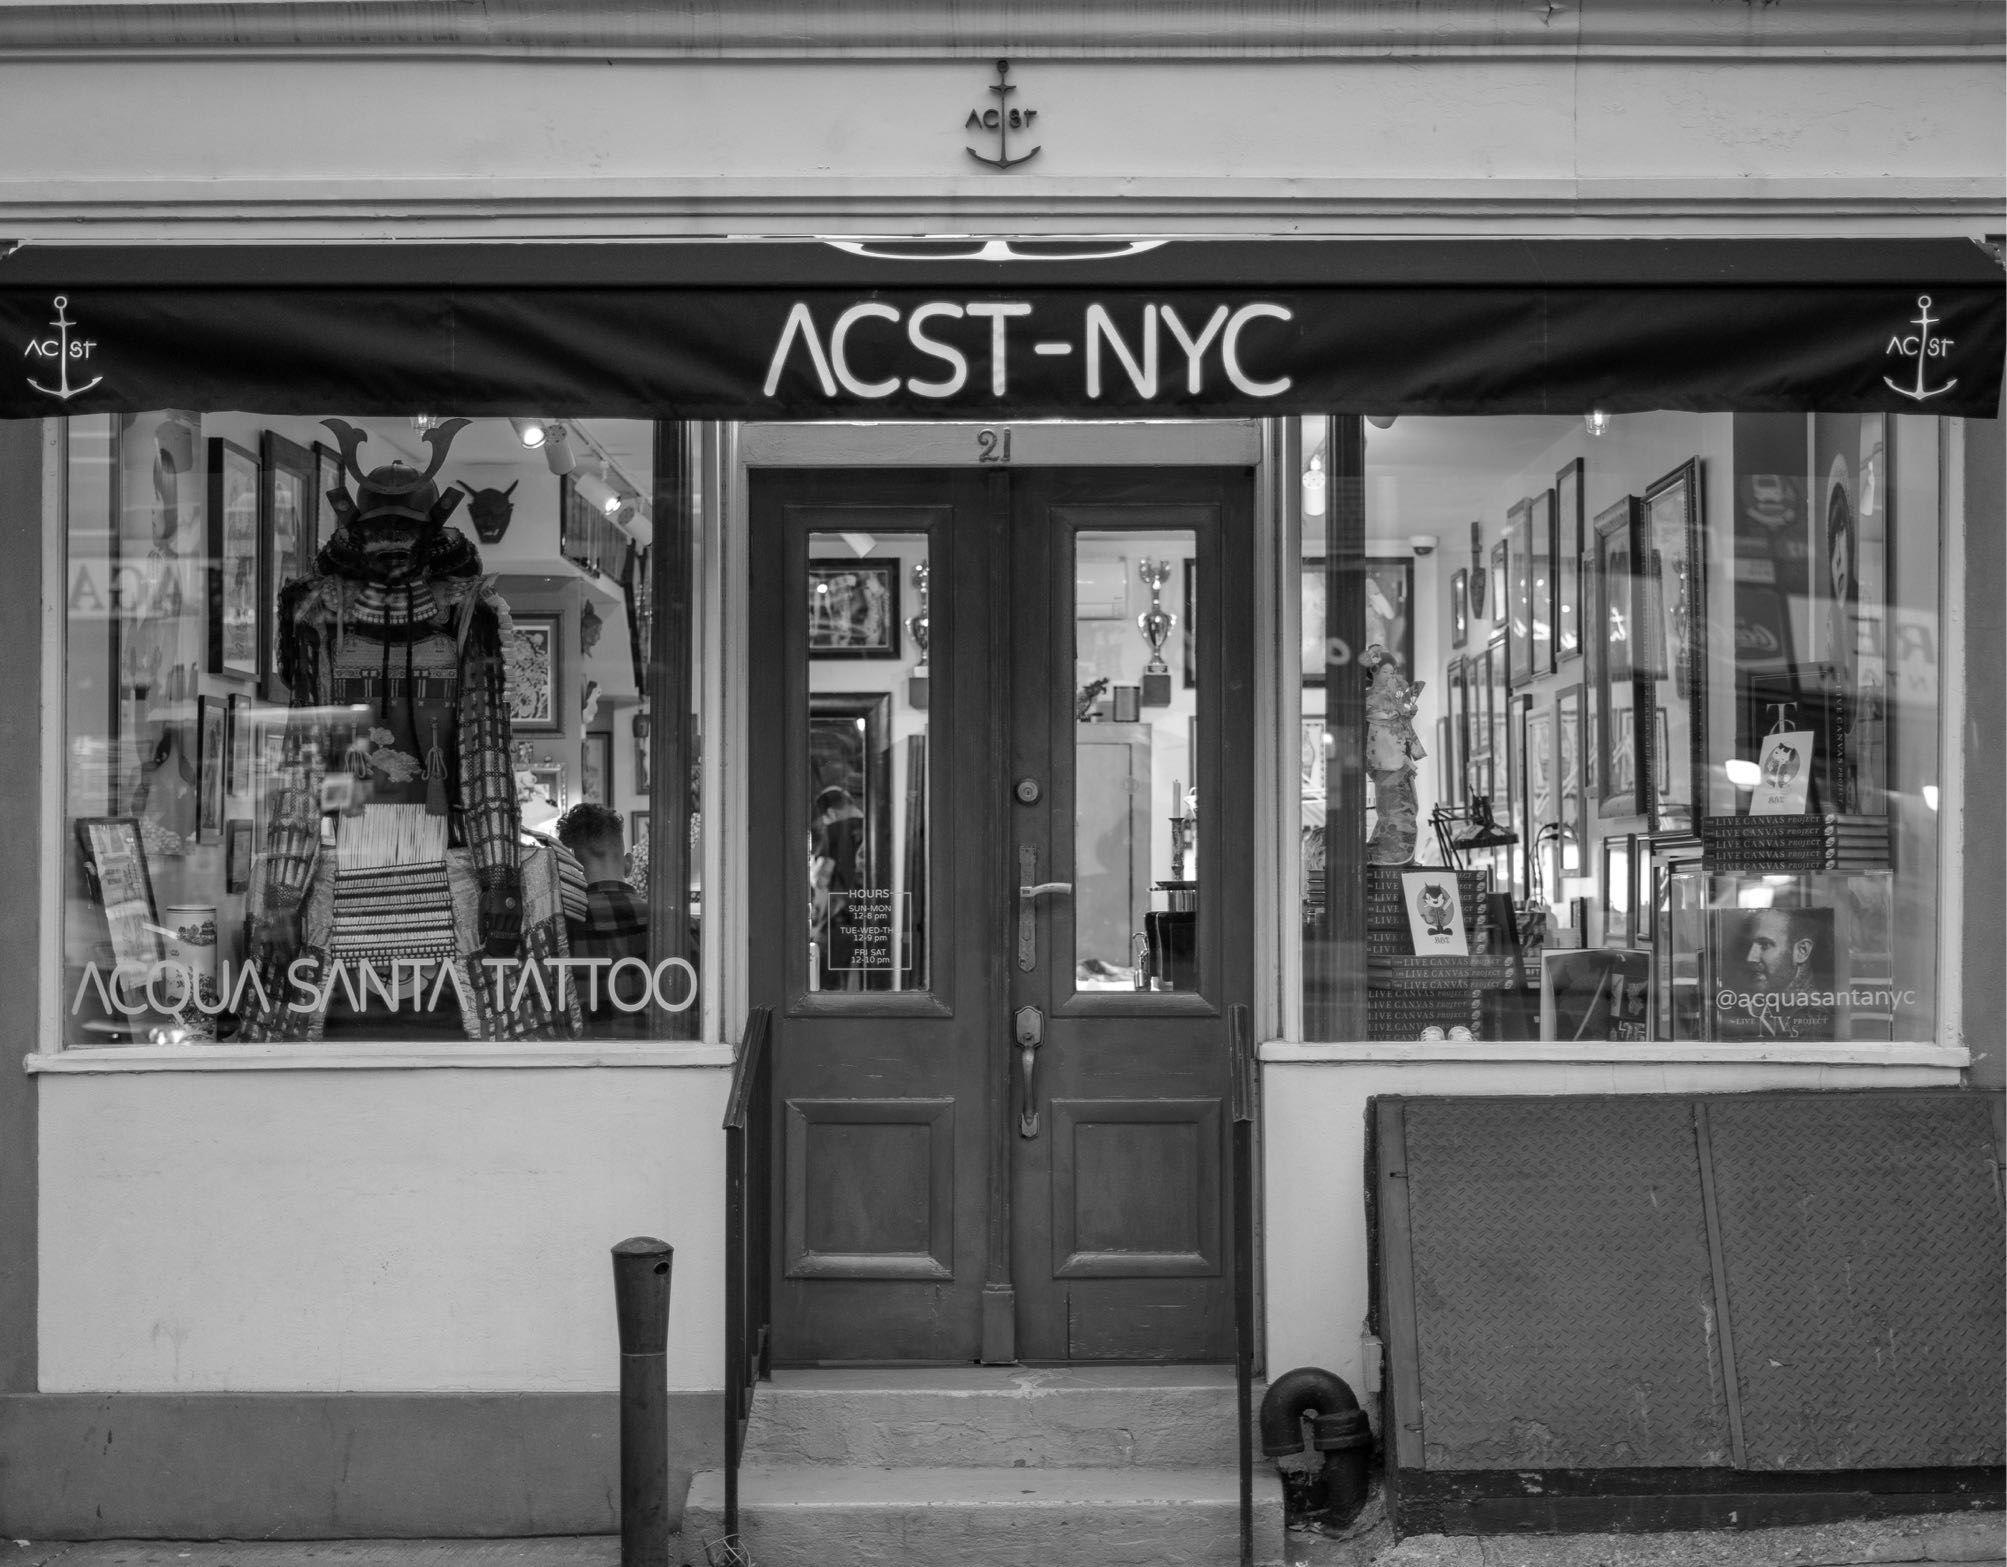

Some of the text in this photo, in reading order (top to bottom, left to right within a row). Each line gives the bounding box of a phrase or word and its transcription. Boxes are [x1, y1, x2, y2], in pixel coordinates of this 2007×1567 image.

[977, 427, 1012, 464] 21
[1836, 716, 1844, 764] CANVAS
[1716, 818, 1741, 826] LIVE
[1743, 816, 1785, 825] CANVAS
[1787, 815, 1820, 825] PROJECT
[1715, 829, 1740, 837] LIVE
[1742, 827, 1784, 836] CANVAS
[1786, 827, 1820, 836] PROJECT
[1716, 840, 1741, 849] LIVE
[1743, 839, 1785, 848] CANVAS
[1787, 839, 1821, 848] PROJECT
[1716, 852, 1741, 860] LIVE
[1743, 850, 1785, 859] CANVAS
[1787, 850, 1821, 860] PROJECT
[1716, 863, 1741, 872] LIVE
[1743, 862, 1785, 870] CANVAS
[1787, 862, 1821, 871] PROJECT
[1374, 871, 1399, 879] LIVE
[1375, 882, 1399, 890] LIVE
[849, 889, 890, 898] HOURS
[1374, 894, 1399, 902] LIVE
[848, 904, 892, 912] SUN-MON
[1375, 905, 1400, 913] LIVE
[853, 912, 888, 921] 12-8 pm
[1375, 916, 1399, 924] LIVE
[853, 934, 873, 942] 12-9
[854, 948, 887, 956] FRI SAT
[851, 956, 890, 965] 12-10 pm
[1404, 958, 1428, 967] LIVE
[1430, 958, 1468, 966] CANVAS
[1405, 969, 1429, 978] LIVE
[1431, 969, 1469, 978] CANVAS
[1404, 981, 1428, 989] LIVE
[1430, 981, 1468, 989] CANVAS
[71, 957, 698, 1026] ACQUA SANTA TATTOO
[1368, 990, 1392, 998] LIVE
[1395, 990, 1435, 998] CANVAS
[1367, 1000, 1391, 1009] LIVE
[1394, 1000, 1434, 1009] CANVAS
[1716, 988, 1916, 1012] @acquasantanyc
[1368, 1012, 1392, 1020] LIVE
